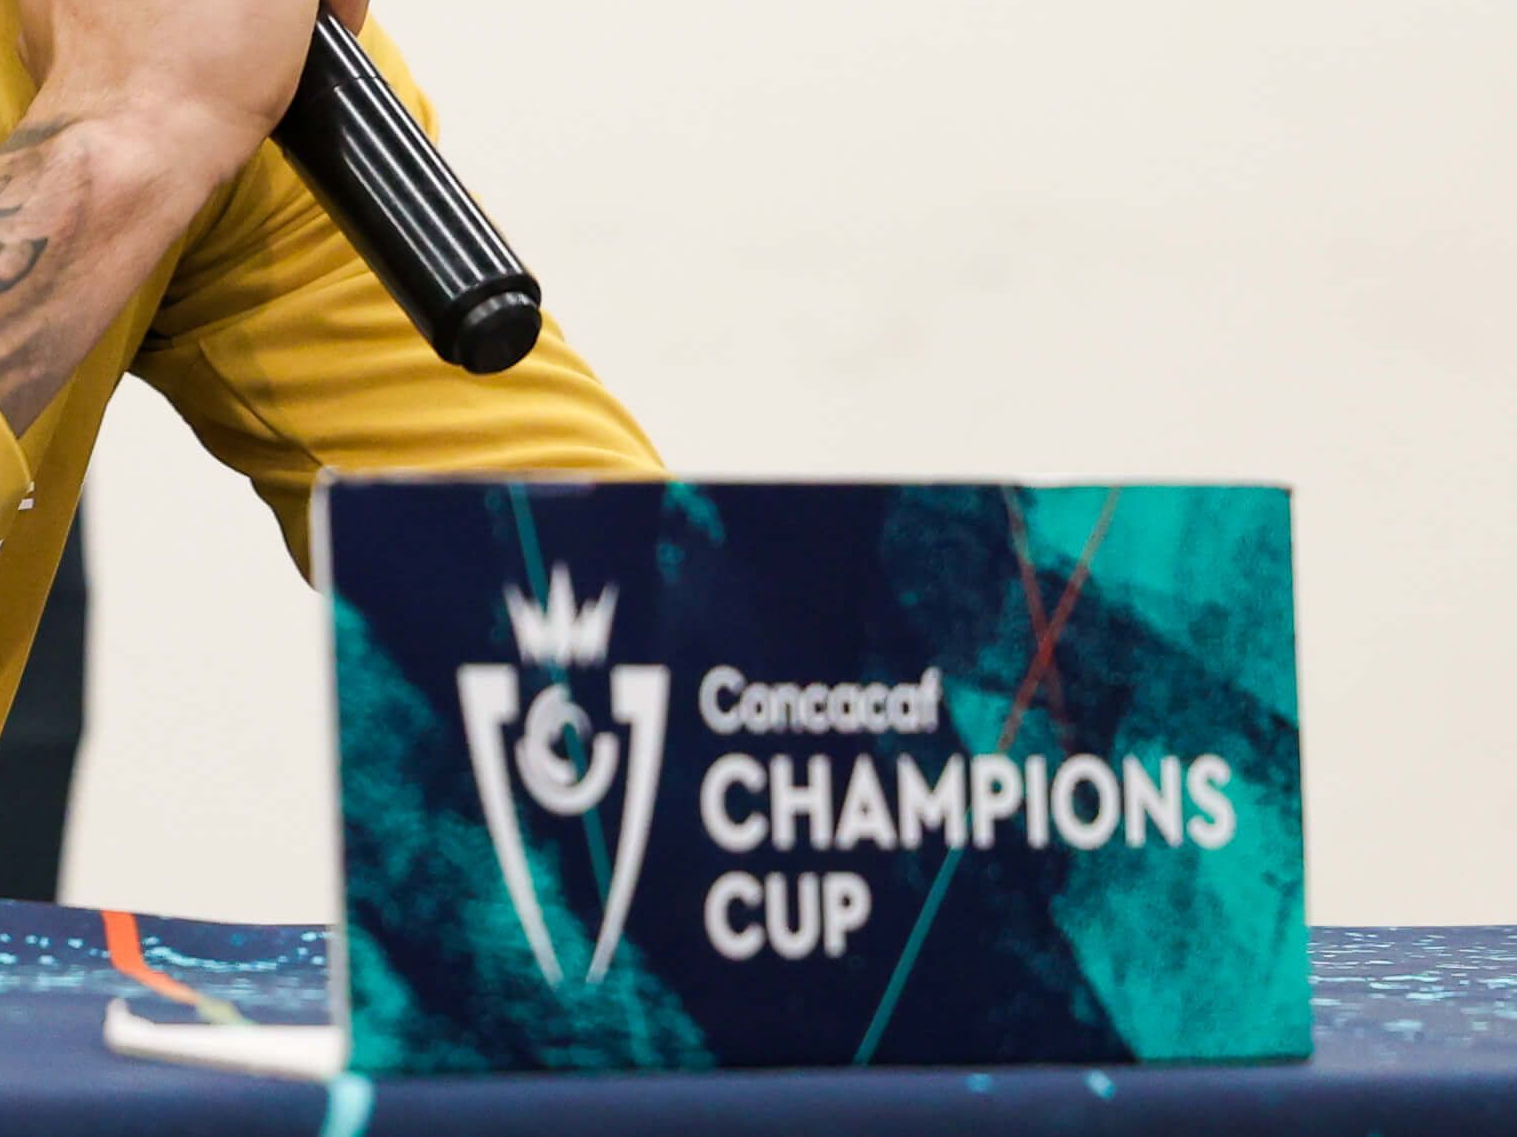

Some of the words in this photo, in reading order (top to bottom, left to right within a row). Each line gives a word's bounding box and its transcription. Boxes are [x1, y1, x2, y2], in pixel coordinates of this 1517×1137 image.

[698, 665, 942, 735] Concacaf
[699, 753, 1236, 852] CHAMPIONS
[703, 871, 872, 959] CUP
